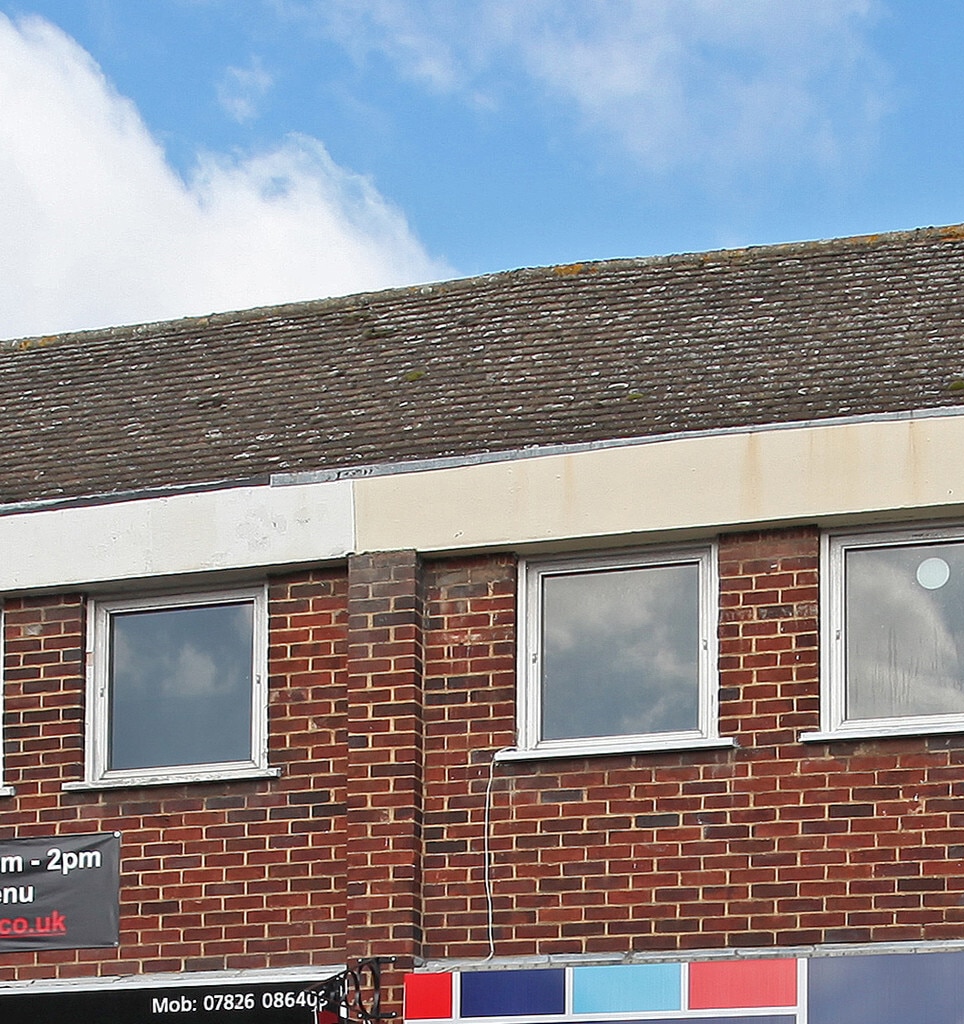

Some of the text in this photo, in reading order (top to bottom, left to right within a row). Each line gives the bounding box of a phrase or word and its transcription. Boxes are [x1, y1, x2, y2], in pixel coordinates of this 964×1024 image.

[47, 848, 101, 875] 2pm
[0, 885, 34, 904] nu
[152, 996, 197, 1013] Mob:
[203, 994, 255, 1011] 07826
